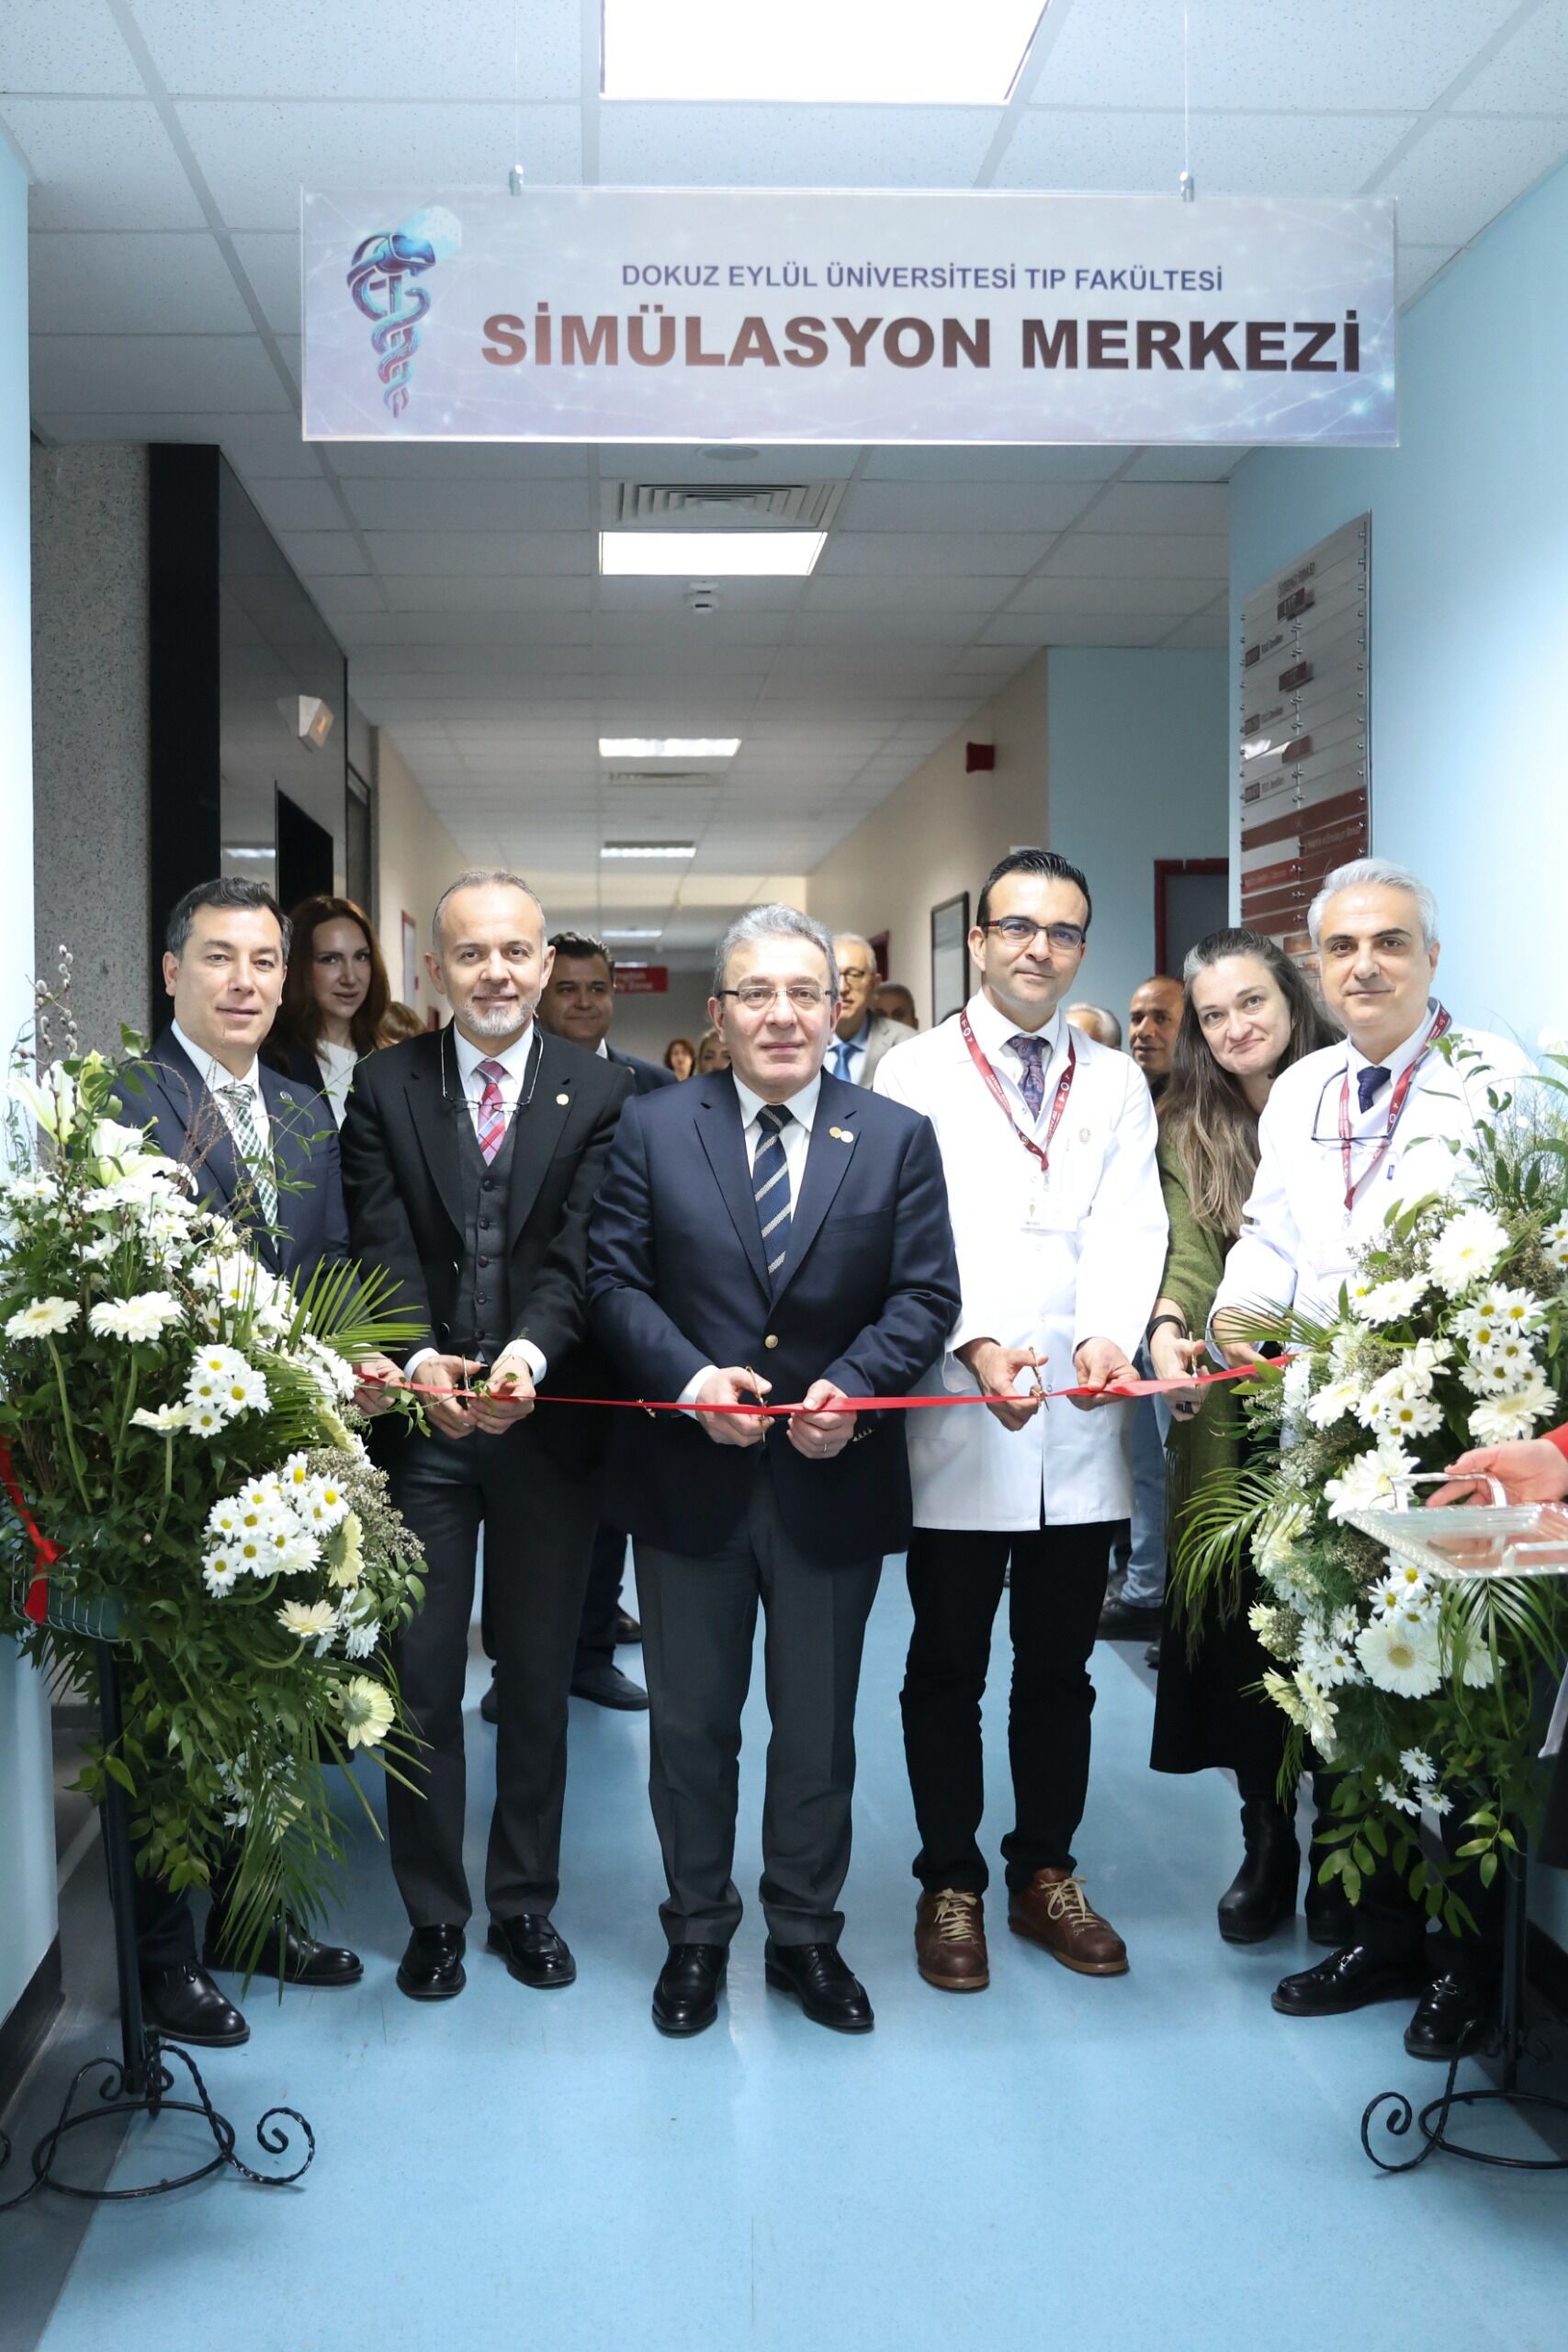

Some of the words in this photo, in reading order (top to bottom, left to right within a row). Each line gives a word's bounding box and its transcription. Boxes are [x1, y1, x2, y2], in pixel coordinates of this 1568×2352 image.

[622, 265, 720, 287] DOKUZ
[728, 261, 818, 288] EYLÜL
[827, 261, 1016, 289] ÜNİVERSİTESİ
[1024, 267, 1066, 290] TIP
[1075, 264, 1224, 292] FAKÜLTESİ
[480, 301, 991, 369] SİMÜLASYON
[1021, 310, 1361, 373] MERKEZİ
